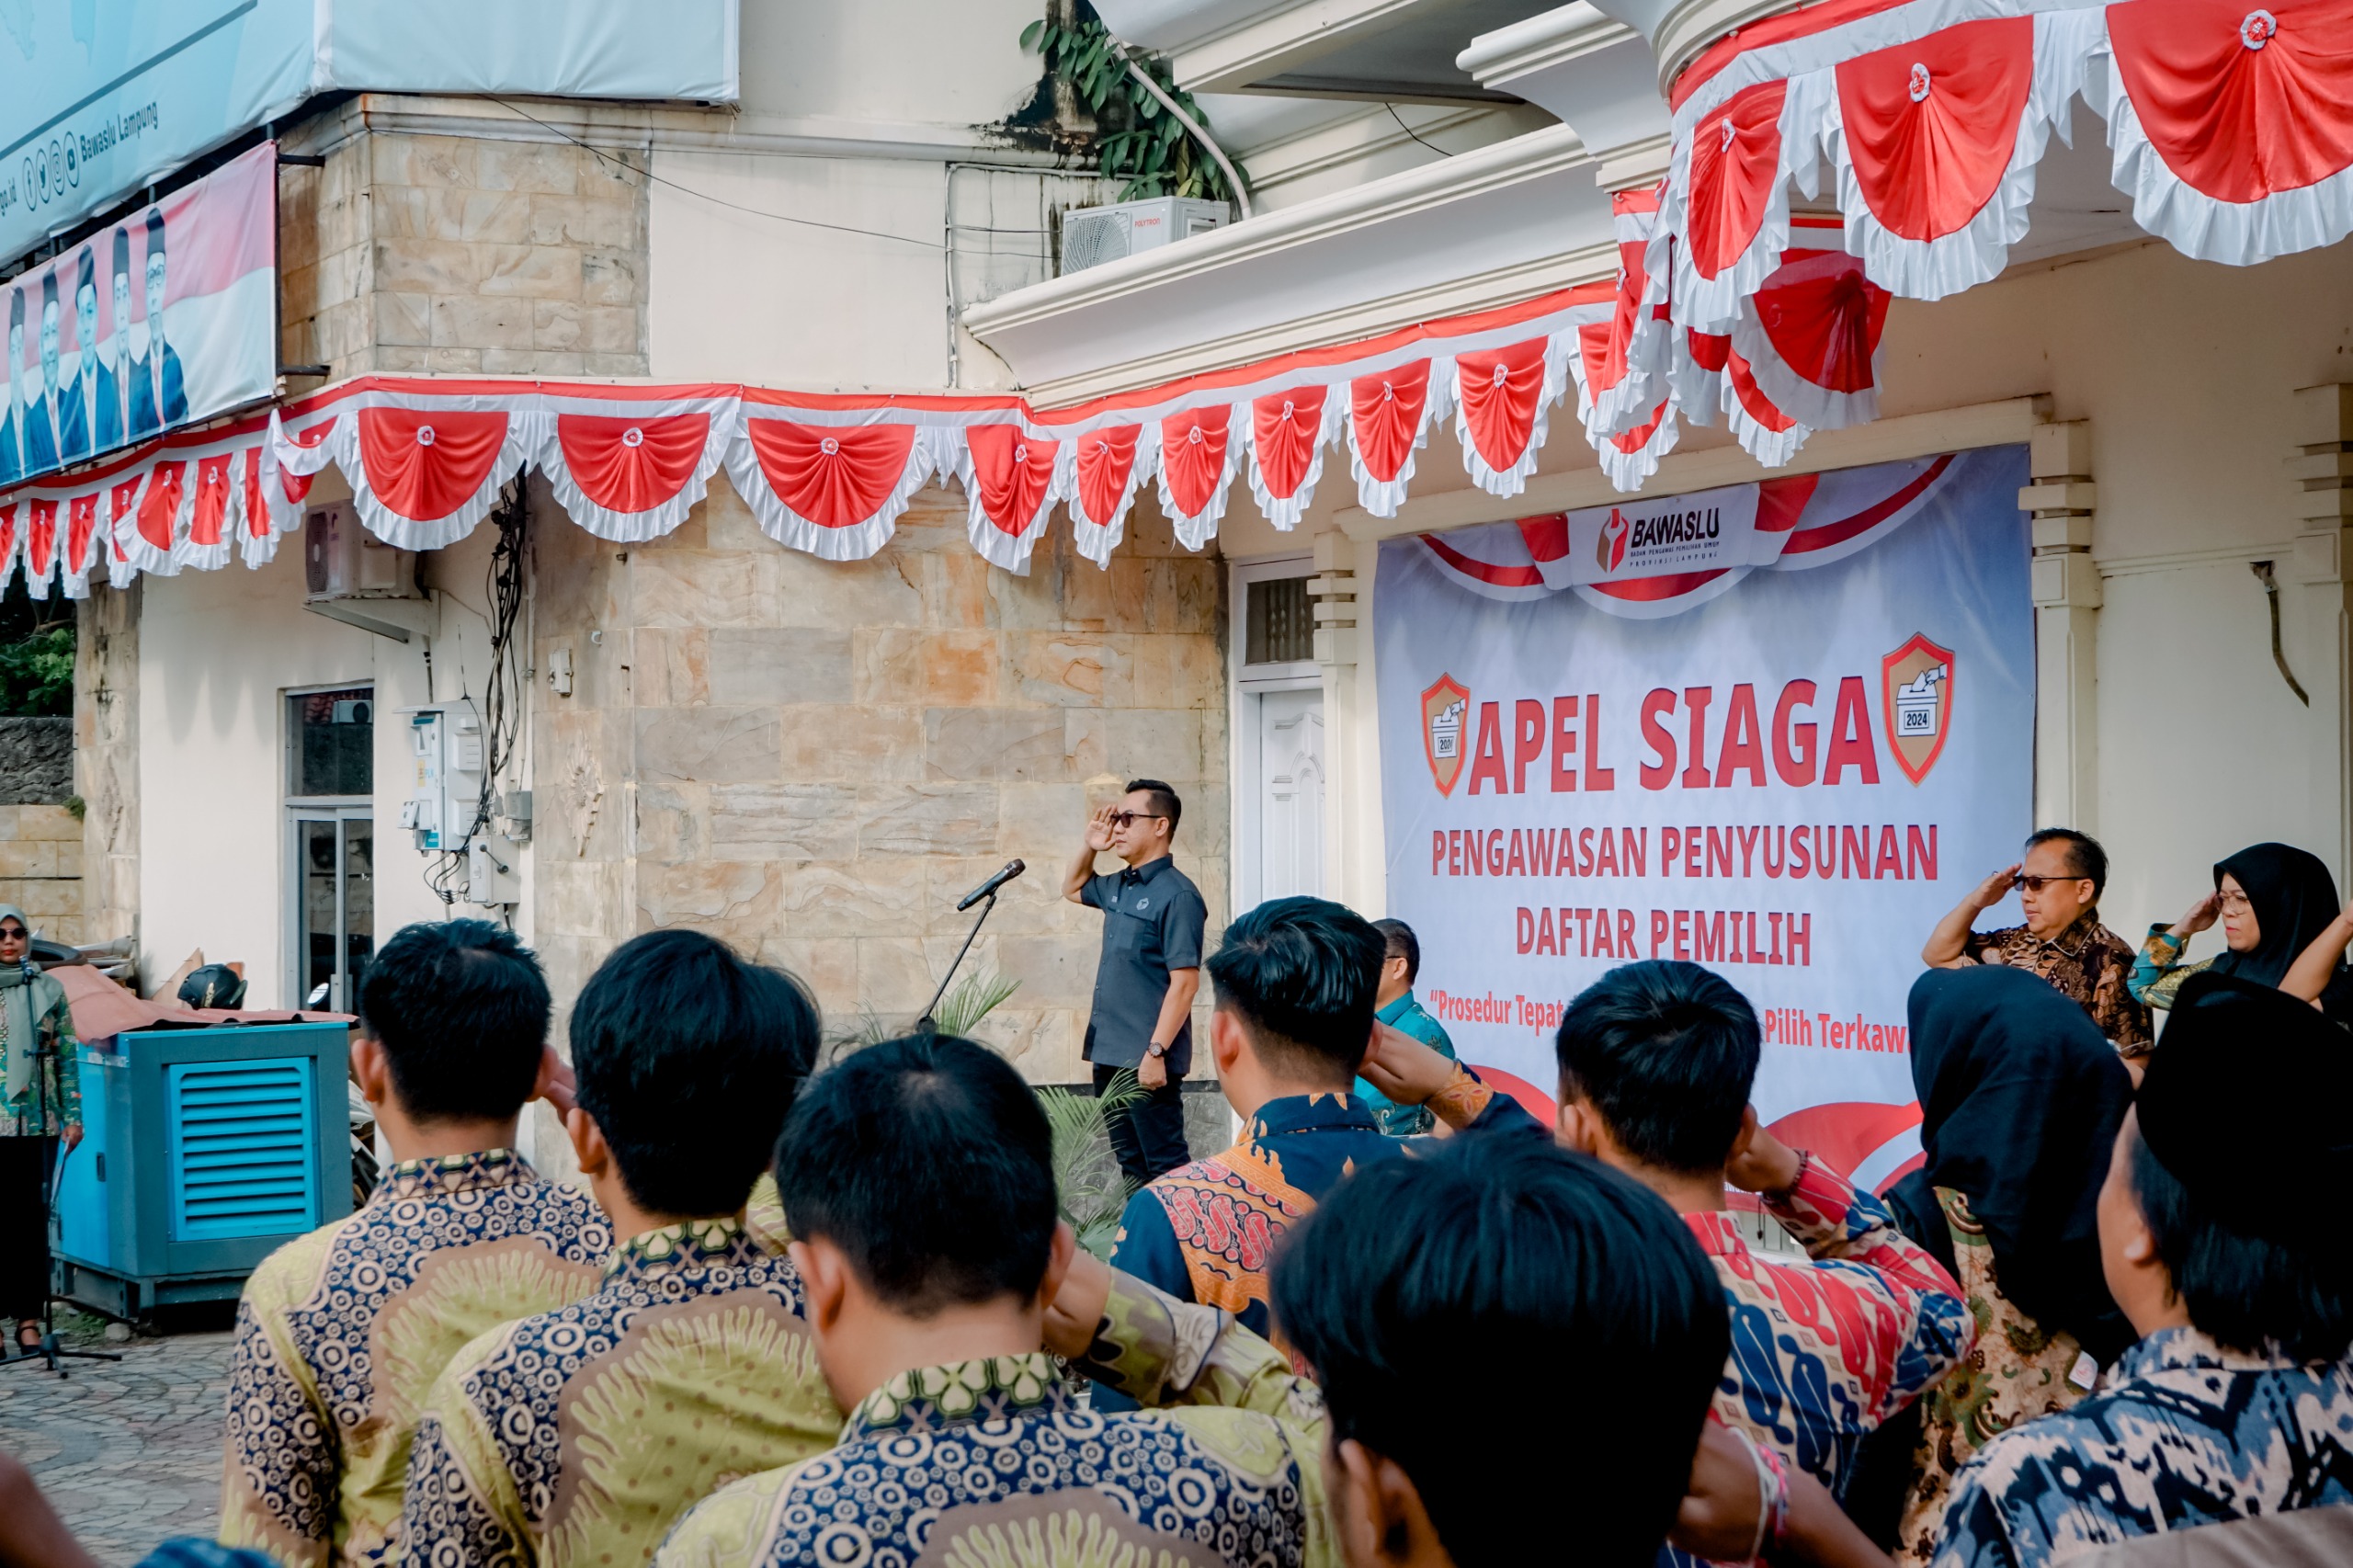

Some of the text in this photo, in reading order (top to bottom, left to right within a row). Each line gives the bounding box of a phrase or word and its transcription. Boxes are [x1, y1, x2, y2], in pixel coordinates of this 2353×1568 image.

[79, 101, 158, 163] Bawaslu Lampung
[1134, 218, 1161, 227] POLYTRON
[1631, 507, 1720, 549] BAWASLU
[1649, 547, 1674, 555] PENGAWAS
[1676, 543, 1701, 551] PEMILIHAN
[1630, 551, 1718, 567] PROVINSI LAMPUNG
[1468, 676, 1881, 796] APEL SIAGA
[1906, 712, 1927, 726] 2024
[1432, 824, 1938, 881] PENGAWASAN PENYUSUNAN
[1517, 906, 1812, 966] DAFTAR PEMILIH
[1516, 994, 1564, 1037] Tepat
[1765, 1007, 1813, 1046] Pilih
[1817, 1013, 1912, 1054] Terkaw
